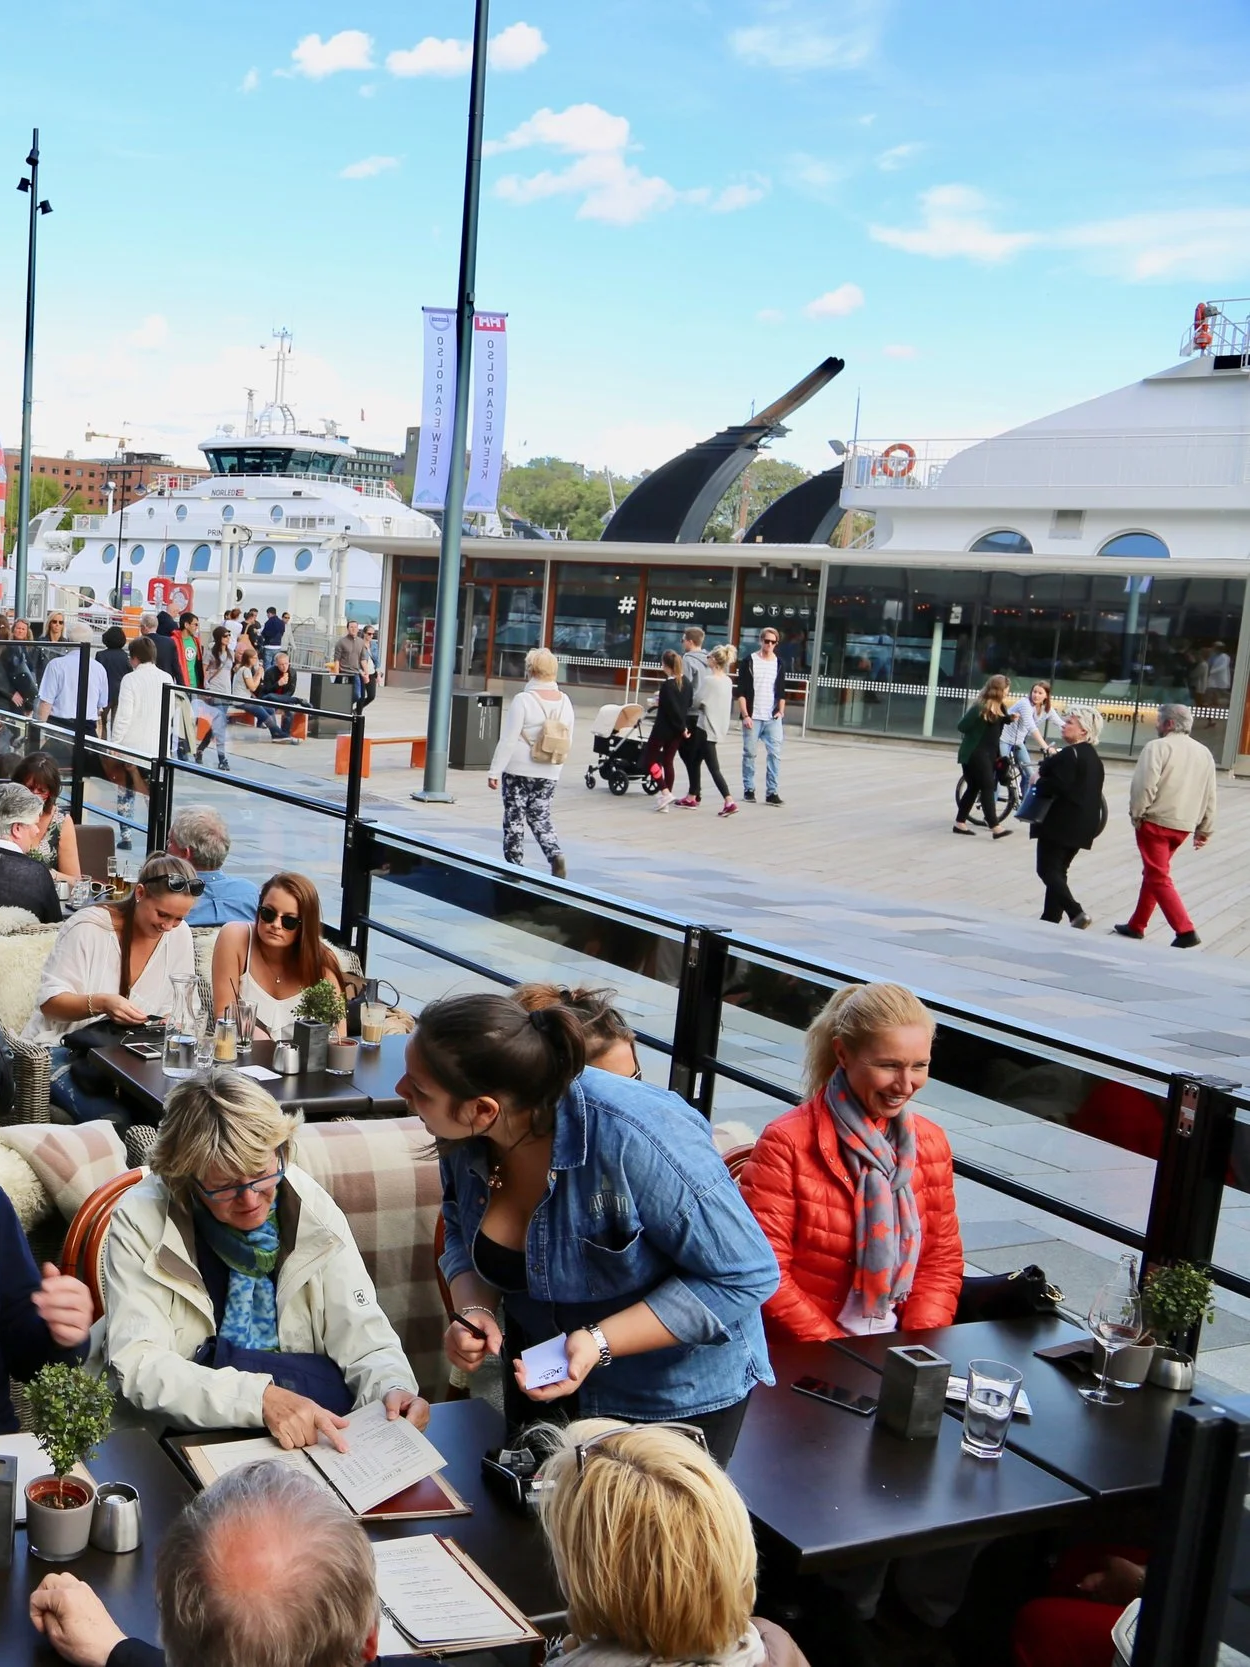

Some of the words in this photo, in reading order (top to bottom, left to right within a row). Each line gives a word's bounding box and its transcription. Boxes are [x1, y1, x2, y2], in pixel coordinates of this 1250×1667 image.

[211, 489, 236, 497] NORLED
[651, 597, 677, 607] Ruters
[677, 600, 728, 610] servicepunkt
[650, 608, 669, 617] Aker
[668, 609, 695, 619] brygge
